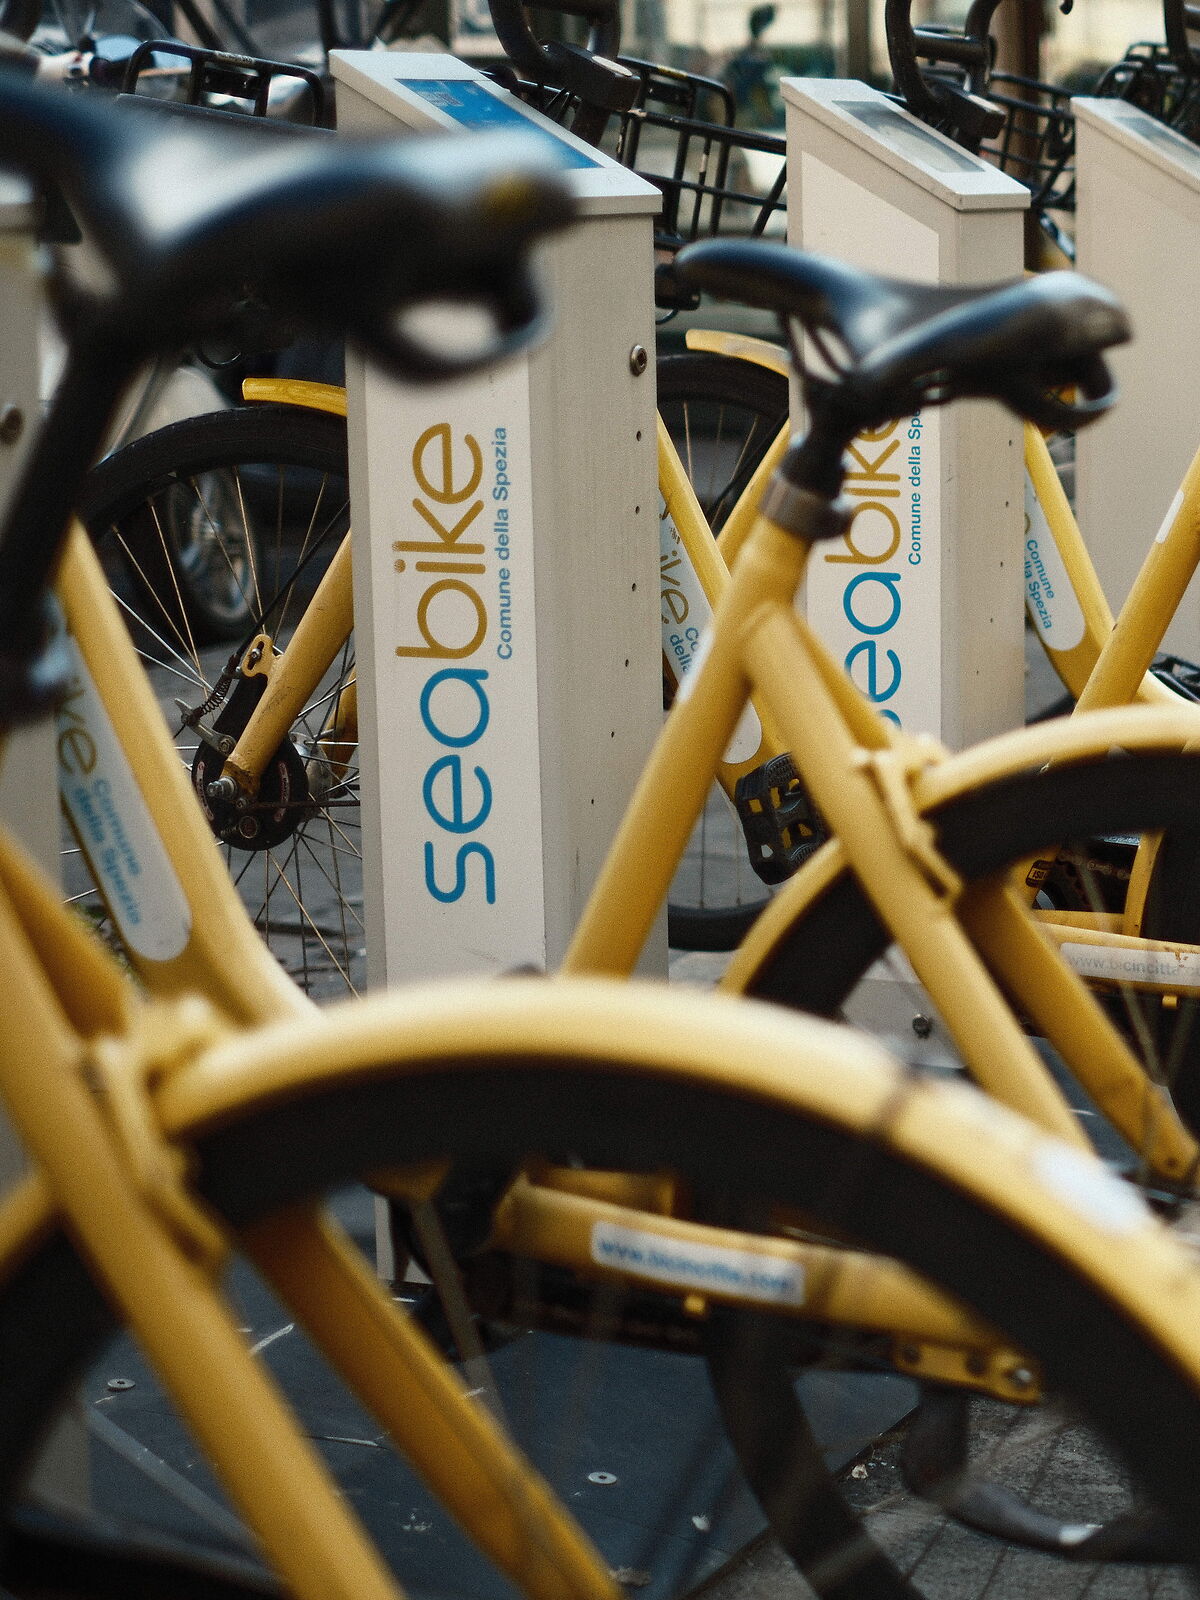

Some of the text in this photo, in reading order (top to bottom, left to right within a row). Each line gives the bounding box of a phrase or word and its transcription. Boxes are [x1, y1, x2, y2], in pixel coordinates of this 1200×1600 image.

[908, 446, 921, 487] della
[492, 427, 513, 660] Comune della Spezia
[908, 493, 922, 566] Comune
[1026, 539, 1055, 599] Comune
[1028, 581, 1053, 629] Spezia
[392, 422, 496, 905] seabike
